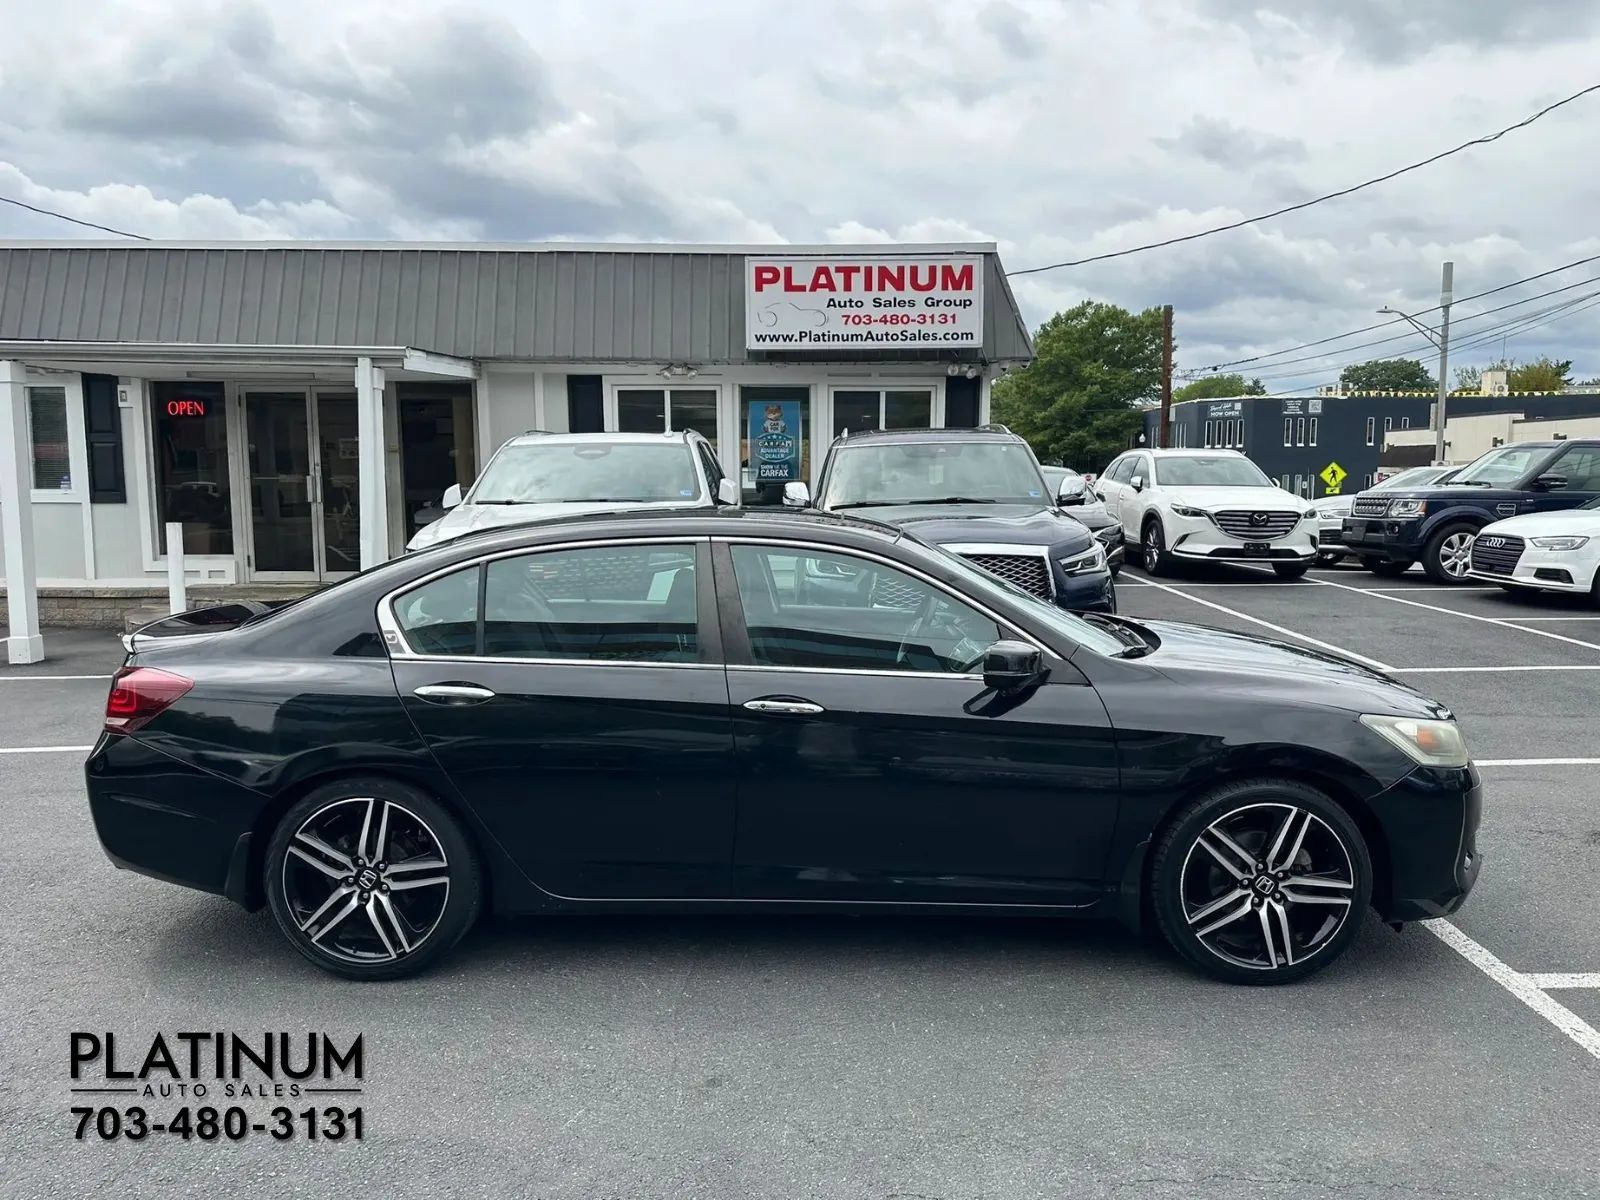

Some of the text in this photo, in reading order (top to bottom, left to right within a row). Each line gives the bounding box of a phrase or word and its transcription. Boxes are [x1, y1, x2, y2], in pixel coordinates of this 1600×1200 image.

[754, 265, 974, 292] PLATINUM
[826, 297, 973, 309] Auto Sales Group
[841, 313, 957, 326] 703-480-3131
[754, 329, 974, 343] www.PlatinumAutoSales.com
[168, 400, 204, 416] OPEN
[760, 469, 789, 477] CARFAX
